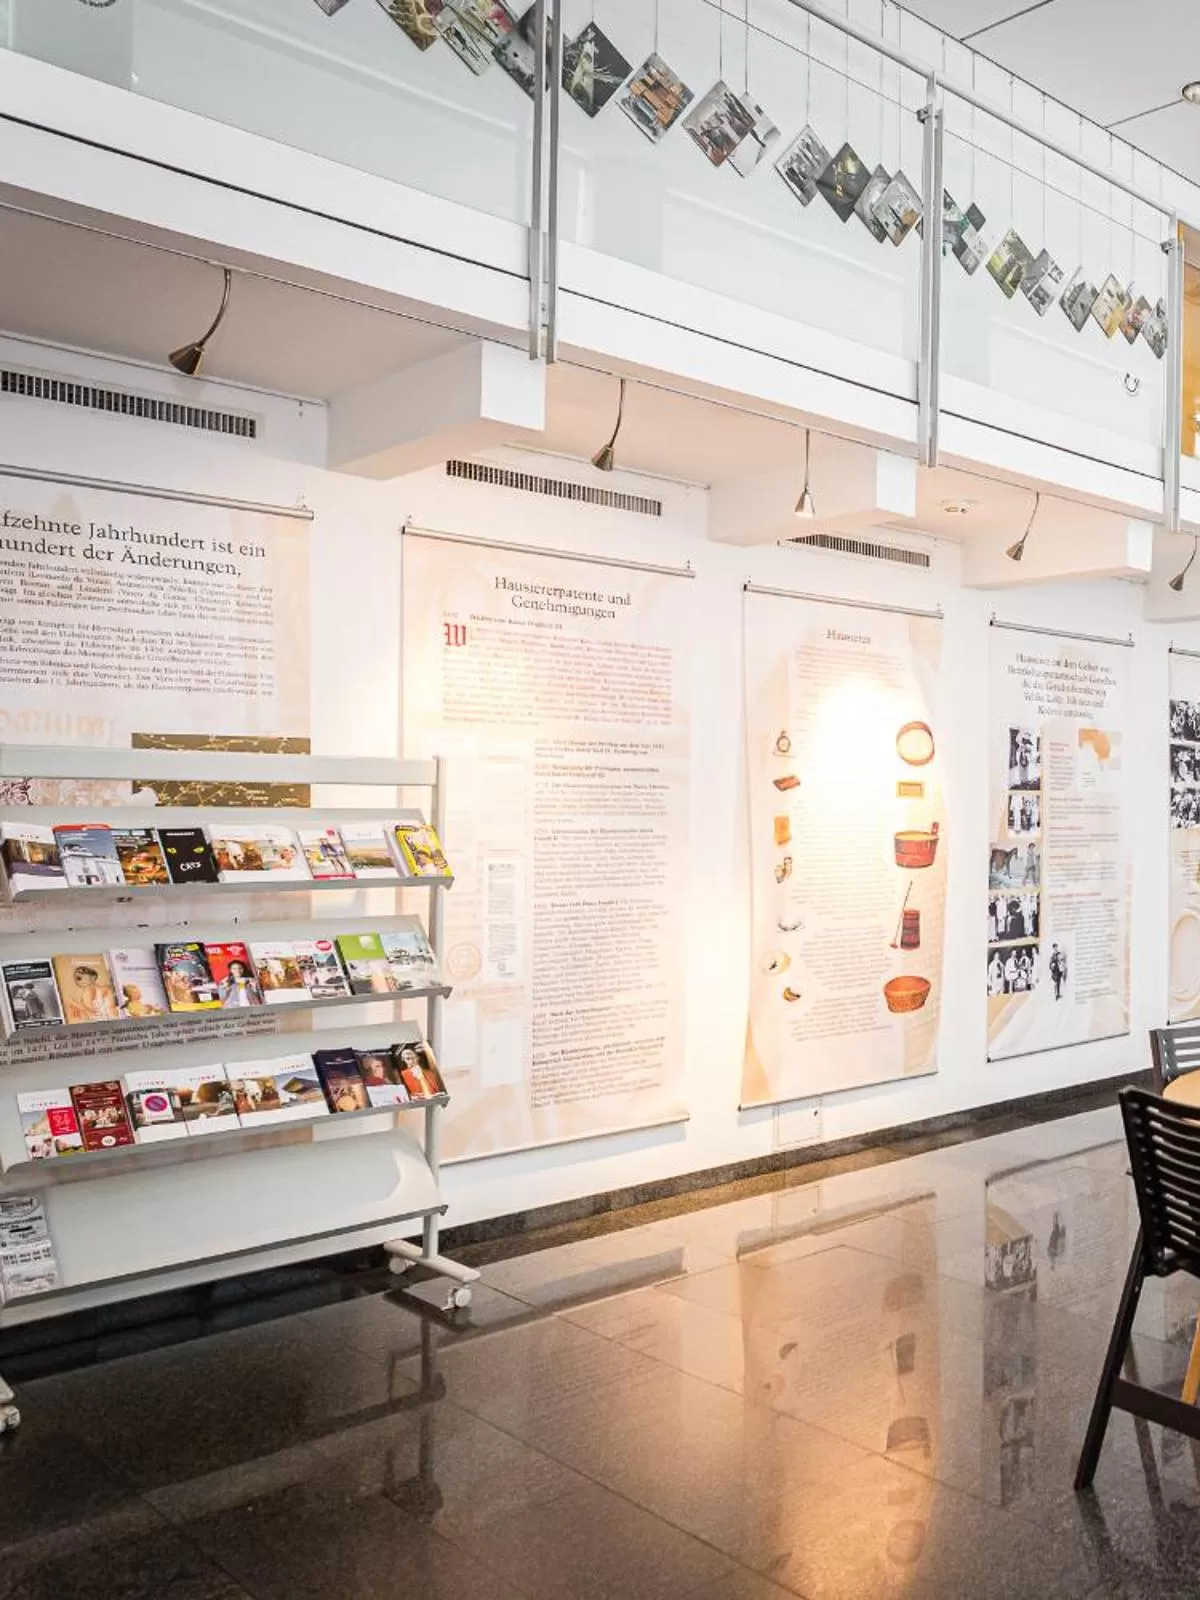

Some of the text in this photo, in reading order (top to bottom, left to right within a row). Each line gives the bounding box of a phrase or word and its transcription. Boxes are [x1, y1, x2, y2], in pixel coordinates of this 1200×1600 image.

[89, 522, 205, 550] Jahrhundert
[212, 538, 233, 554] ist
[239, 543, 265, 557] ein
[82, 544, 114, 561] der
[511, 594, 616, 620] Genehmigungen
[607, 592, 632, 606] und
